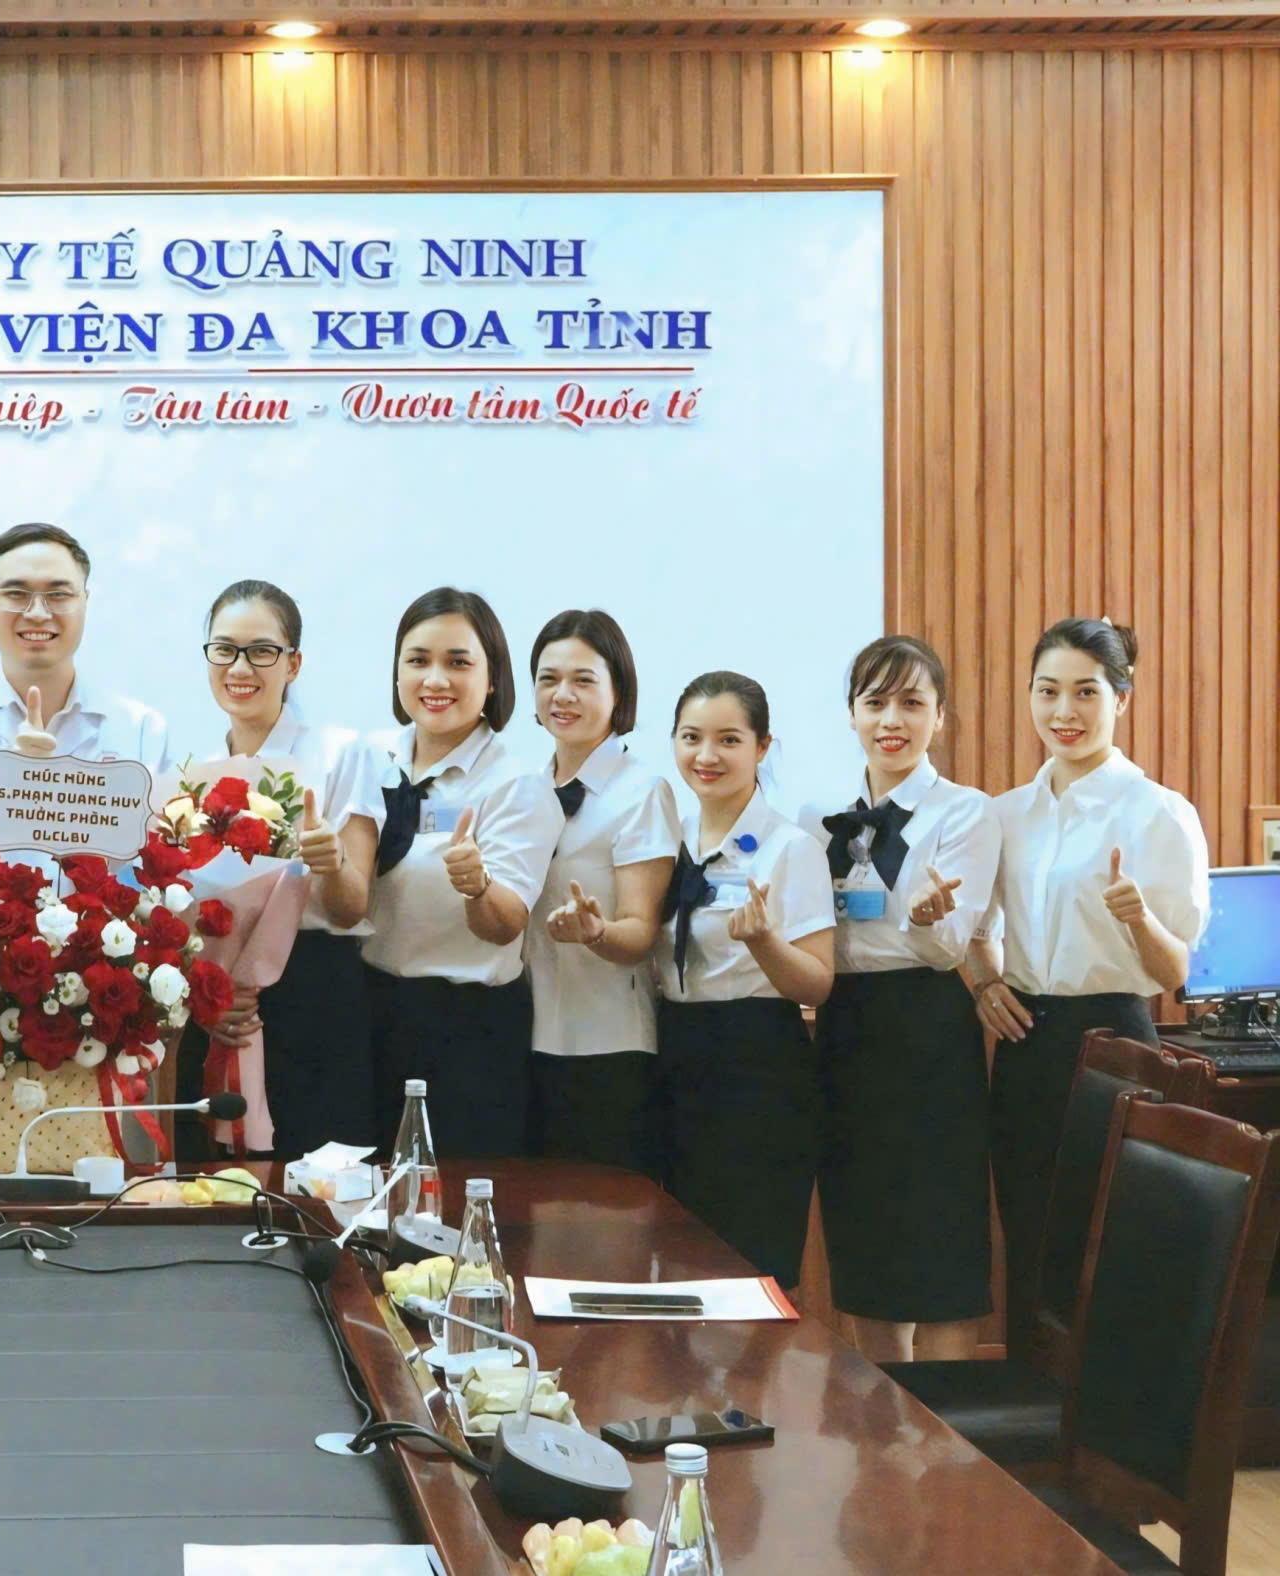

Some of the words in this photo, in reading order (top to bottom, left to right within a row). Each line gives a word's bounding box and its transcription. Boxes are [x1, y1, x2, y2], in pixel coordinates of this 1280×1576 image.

[58, 228, 139, 282] TẾ
[163, 230, 394, 290] QUẢNG
[421, 239, 588, 278] NINH
[187, 311, 284, 352] ĐA
[311, 309, 516, 351] KHOA
[537, 298, 713, 350] TỈNH
[121, 386, 203, 429] Tận
[215, 391, 291, 421] tâm
[467, 385, 543, 420] tầm
[555, 382, 651, 428] Quốc
[666, 387, 703, 419] tế
[22, 769, 61, 783] CHÚC
[57, 793, 107, 806] QUANG
[111, 797, 141, 809] HUY
[70, 812, 119, 826] PHÒNG
